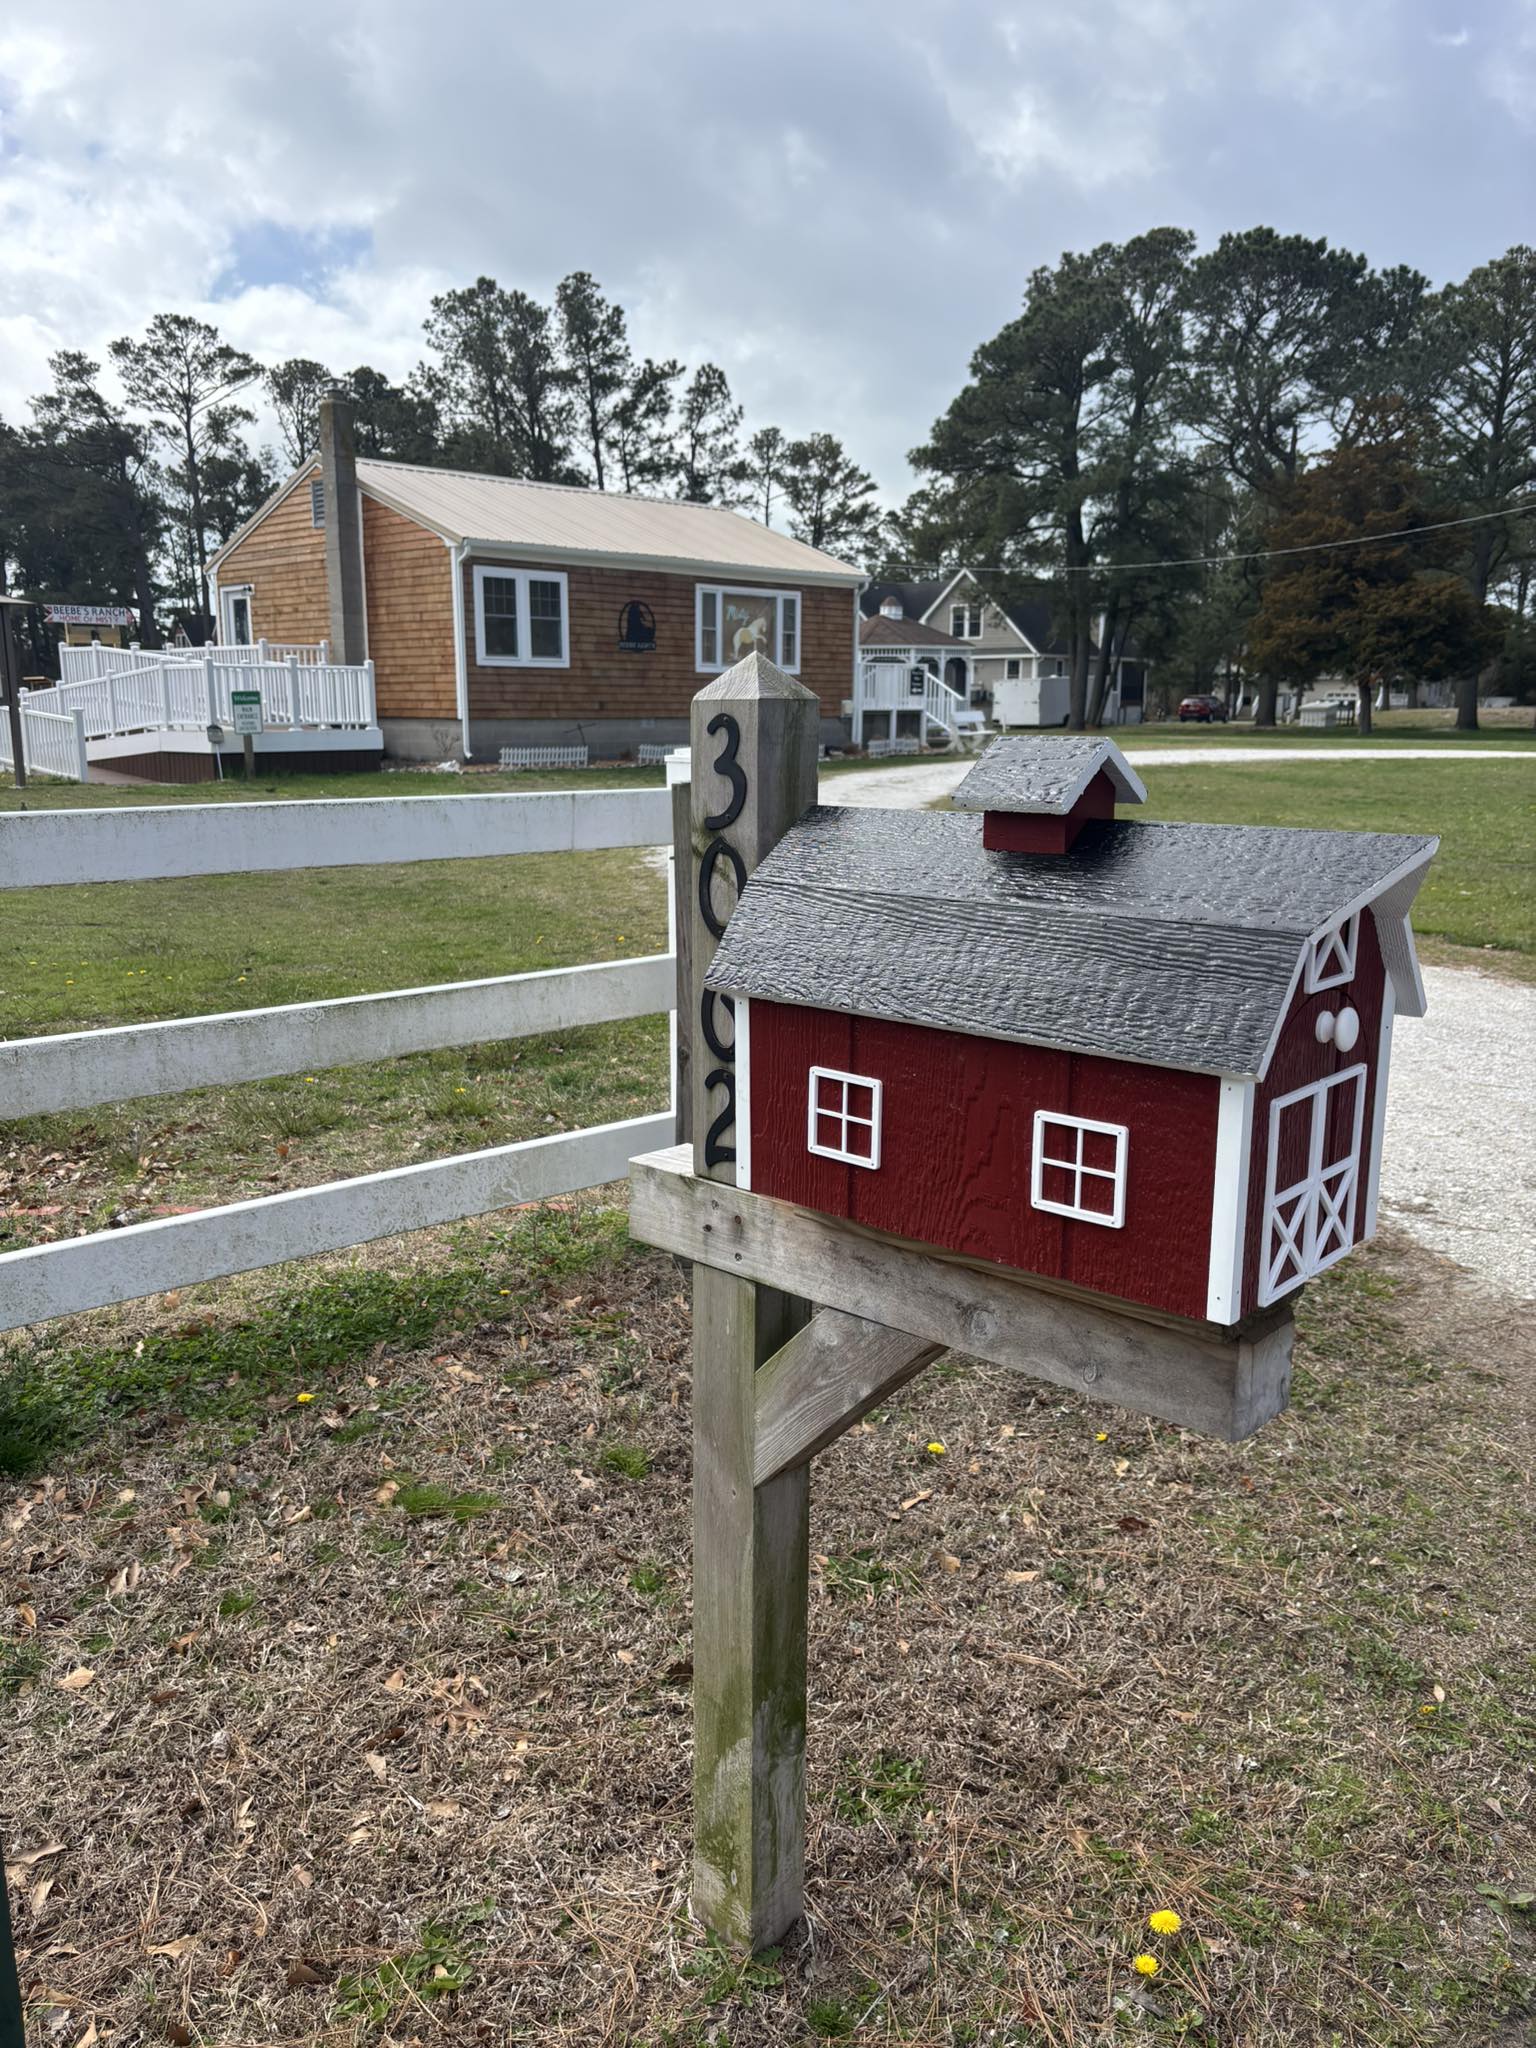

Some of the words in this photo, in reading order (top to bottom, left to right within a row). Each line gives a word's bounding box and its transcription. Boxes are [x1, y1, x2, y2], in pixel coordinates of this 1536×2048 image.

[53, 606, 90, 616] BEEBE'S
[91, 607, 125, 617] RANCH
[60, 615, 81, 623] HOME
[95, 616, 119, 624] MISTY
